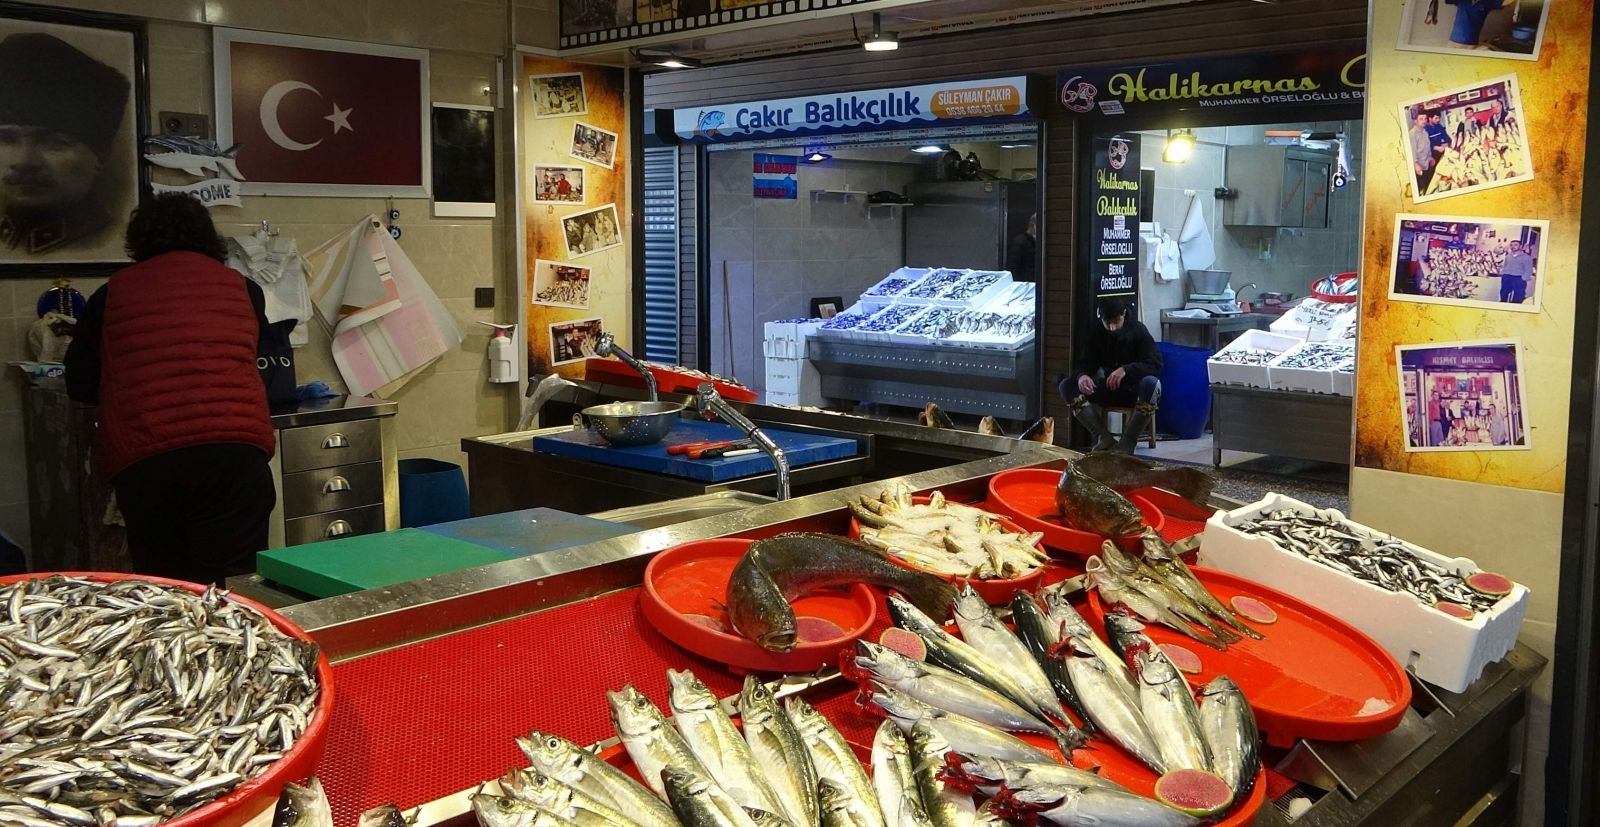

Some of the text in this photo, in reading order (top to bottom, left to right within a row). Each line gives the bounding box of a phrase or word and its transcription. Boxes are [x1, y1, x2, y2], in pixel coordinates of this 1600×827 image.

[1109, 68, 1320, 102] Halikarnas
[938, 88, 1011, 105] SÜLEYMAN ÇAKIR
[1199, 97, 1259, 107] MUHAMMER
[1262, 92, 1338, 104] ÖRSELOĞLU
[736, 91, 921, 133] Çakır Balıkçılık
[1097, 168, 1138, 190] Halikarnas
[1103, 227, 1130, 239] MUHAMMER
[1108, 263, 1125, 275] BERAT
